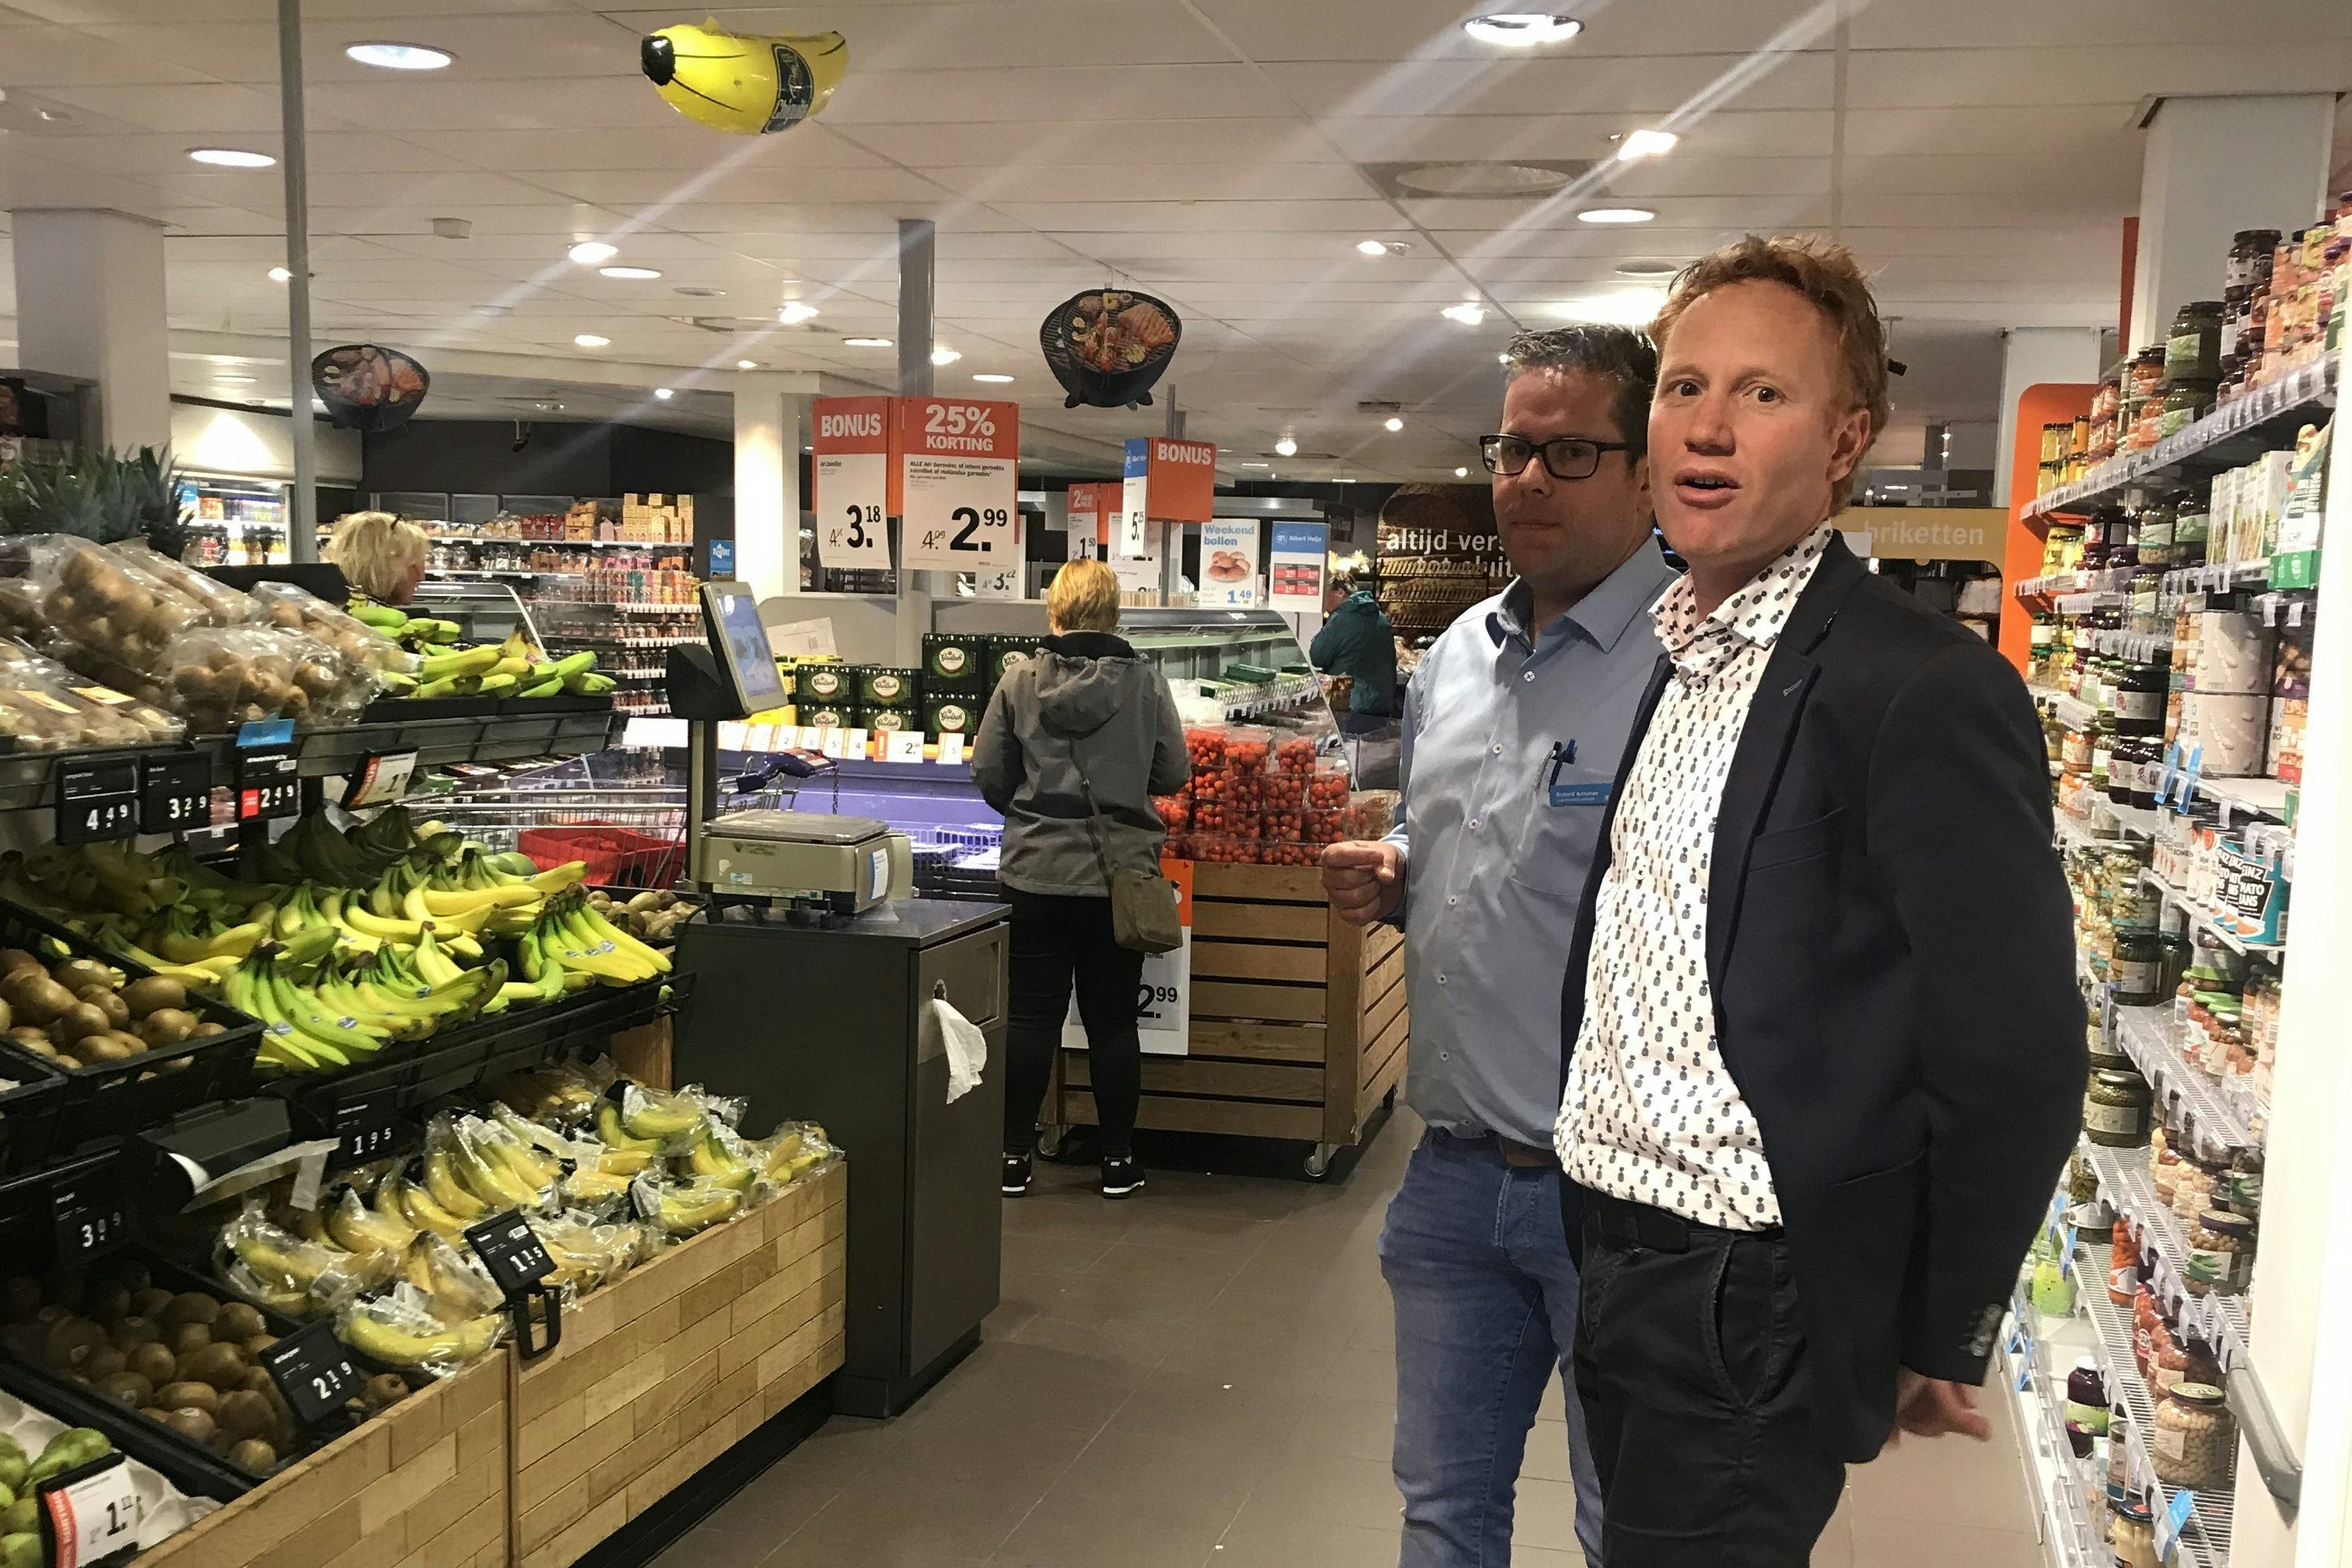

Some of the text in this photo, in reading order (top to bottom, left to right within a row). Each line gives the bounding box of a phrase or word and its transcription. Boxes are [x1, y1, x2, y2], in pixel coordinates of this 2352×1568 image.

[821, 413, 881, 437] BONUS
[925, 404, 996, 436] 25%
[926, 436, 993, 451] KORTING
[1157, 443, 1212, 465] BONUS
[1204, 524, 1255, 536] Weekend
[1204, 536, 1237, 546] bollen
[1386, 528, 1448, 555] altijd
